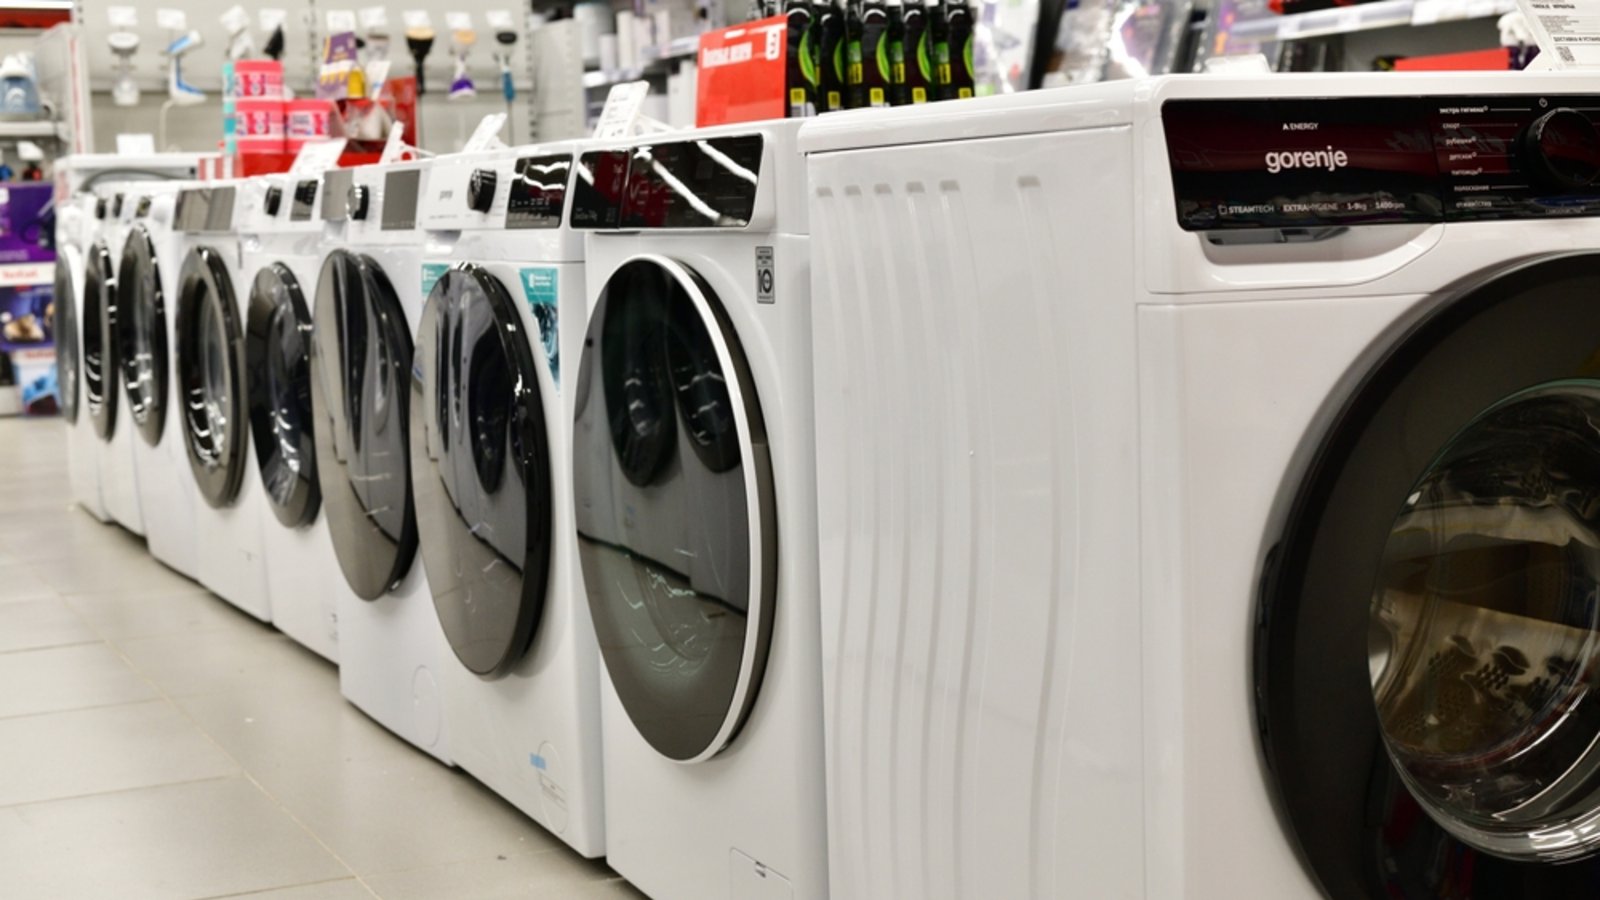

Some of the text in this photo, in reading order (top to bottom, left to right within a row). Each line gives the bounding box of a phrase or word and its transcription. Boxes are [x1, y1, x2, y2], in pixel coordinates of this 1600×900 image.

[1290, 122, 1319, 130] ENERGY
[1266, 146, 1347, 172] gorenje
[1228, 205, 1274, 214] STEAMTECH
[1283, 203, 1338, 212] EXTRAHYGIENE
